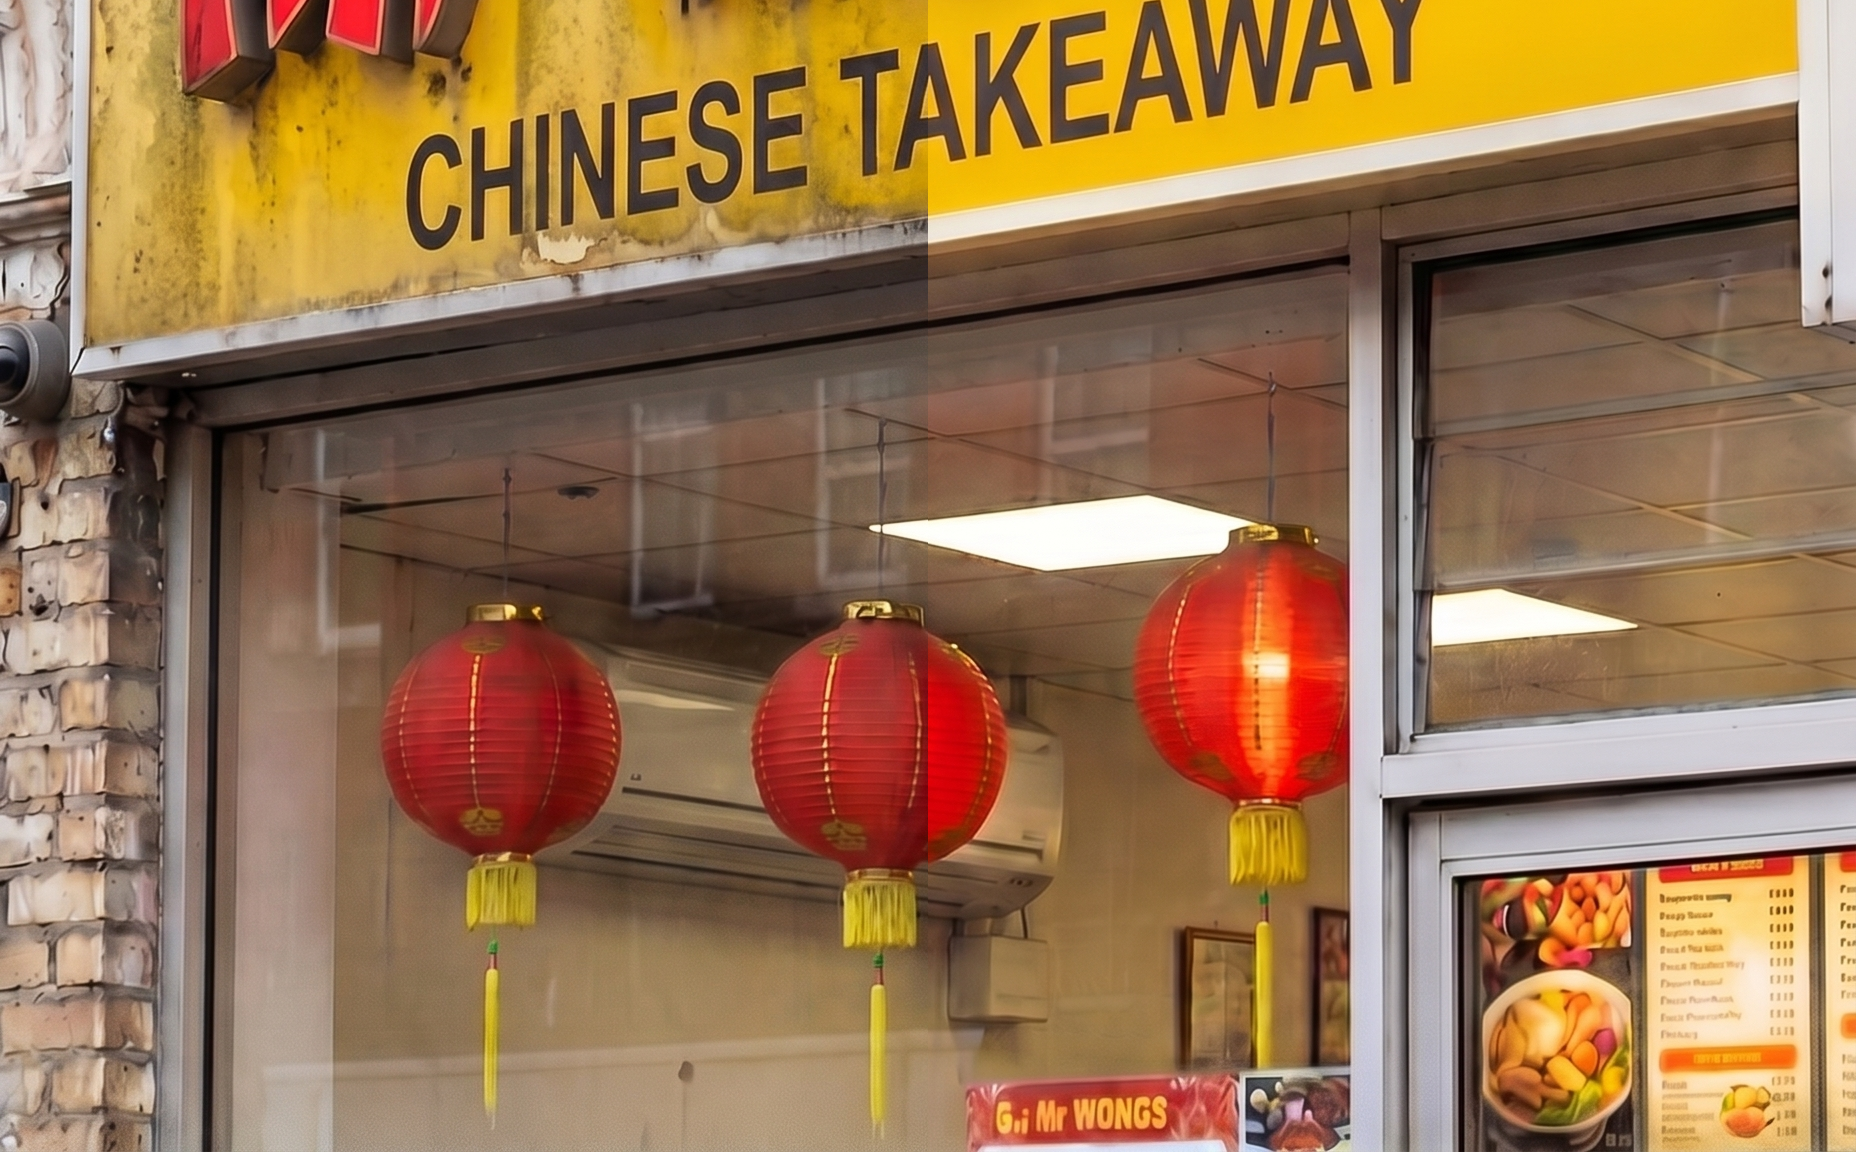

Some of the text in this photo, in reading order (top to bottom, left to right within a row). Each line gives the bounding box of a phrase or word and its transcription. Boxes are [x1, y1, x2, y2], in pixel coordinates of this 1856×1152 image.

[405, 66, 808, 250] CHINESE
[1036, 1100, 1068, 1133] Mr
[1073, 1095, 1168, 1131] WONGS
